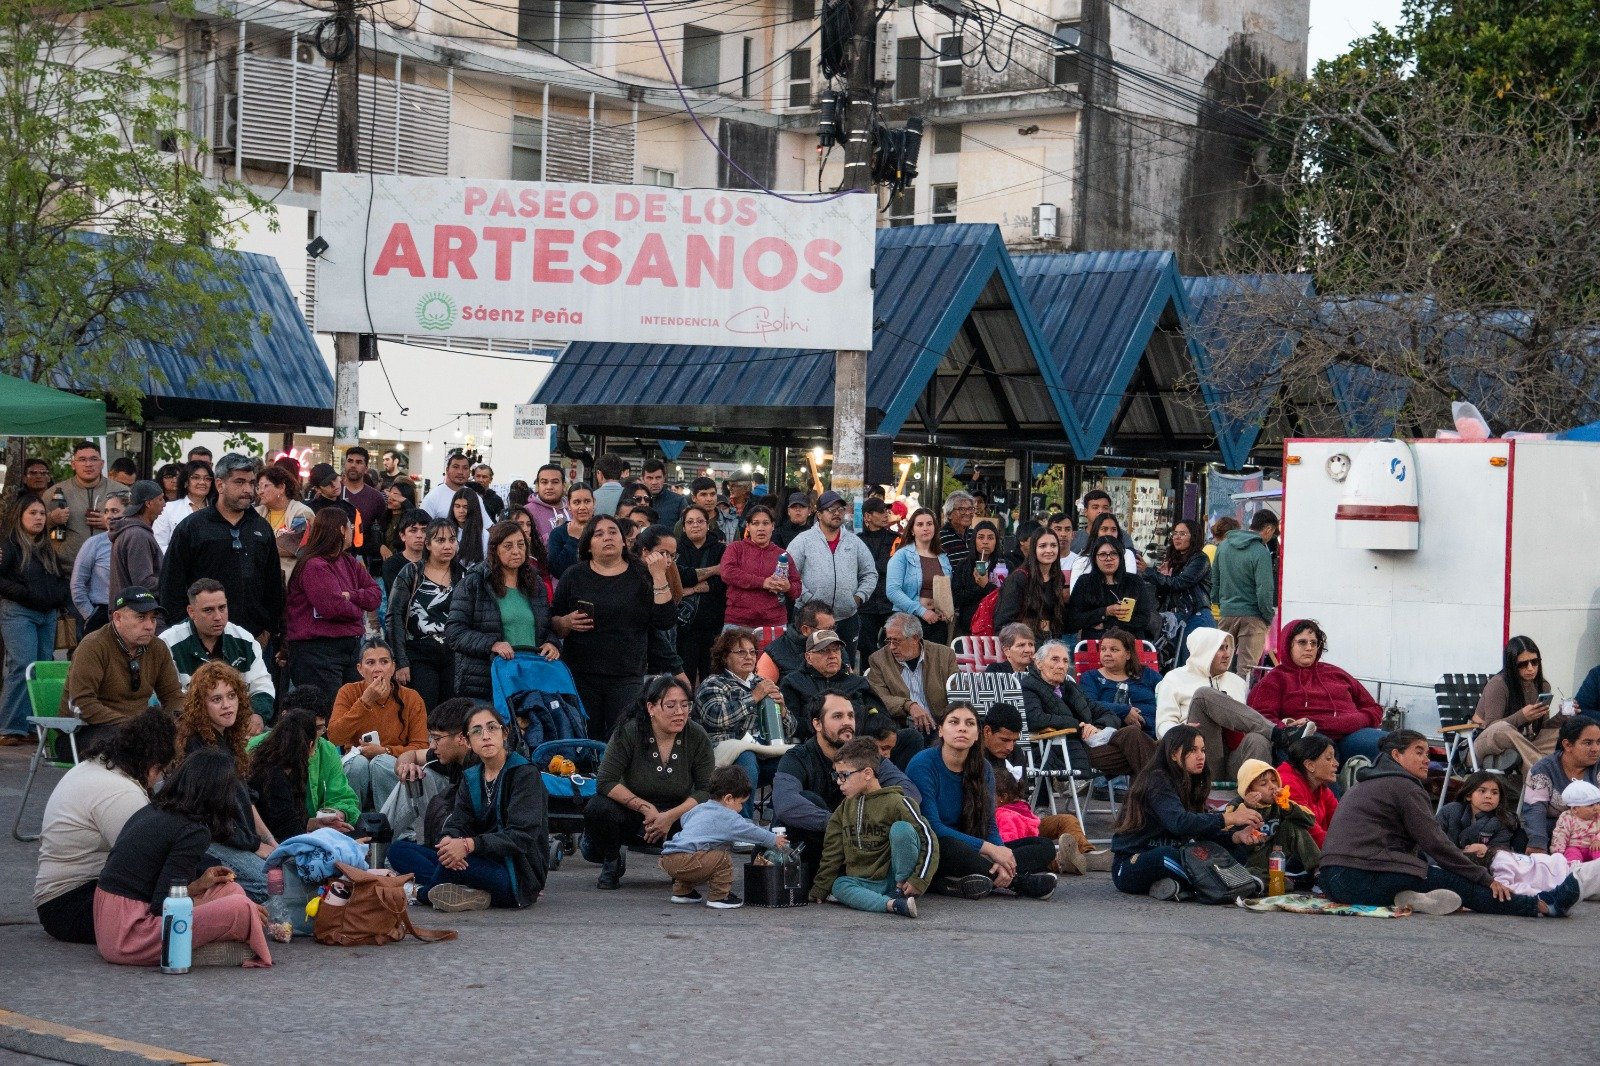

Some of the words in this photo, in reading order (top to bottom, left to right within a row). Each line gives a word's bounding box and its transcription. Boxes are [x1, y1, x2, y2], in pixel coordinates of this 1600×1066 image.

[463, 187, 599, 221] PASEO
[614, 192, 667, 224] DE
[682, 196, 757, 226] LOS
[372, 222, 844, 294] ARTESANOS
[462, 305, 525, 323] Sáenz
[531, 307, 583, 324] Peña
[640, 316, 720, 327] INTENDENCIA
[725, 306, 810, 343] Cipolini
